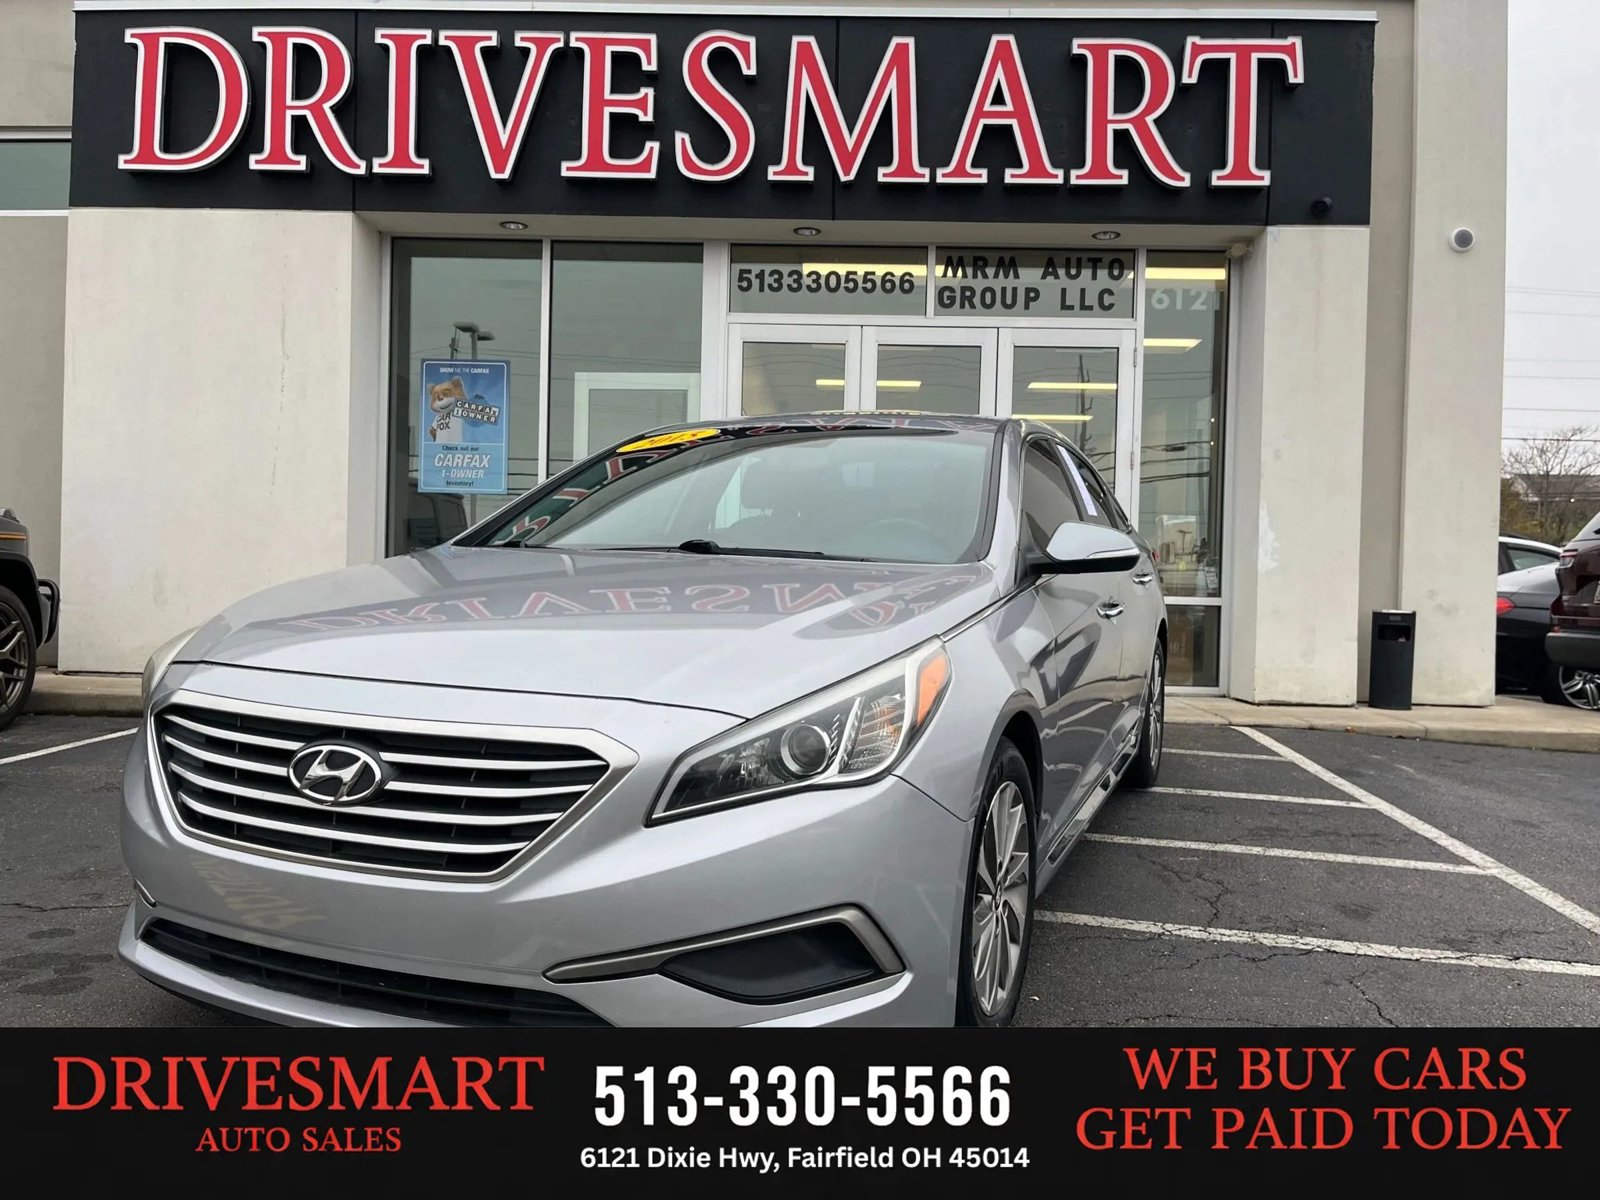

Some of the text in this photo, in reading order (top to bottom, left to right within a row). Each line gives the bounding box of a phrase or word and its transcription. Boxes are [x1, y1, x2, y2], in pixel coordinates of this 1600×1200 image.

[118, 26, 1305, 189] DRIVESMART
[942, 255, 1125, 281] MRM AUTO
[737, 268, 915, 294] 5133305566
[937, 285, 1116, 311] GROUP LLC
[456, 400, 499, 416] CARFAX
[462, 409, 497, 423] OWNER
[434, 453, 491, 468] CARFAX
[441, 469, 485, 479] 1-OWNER
